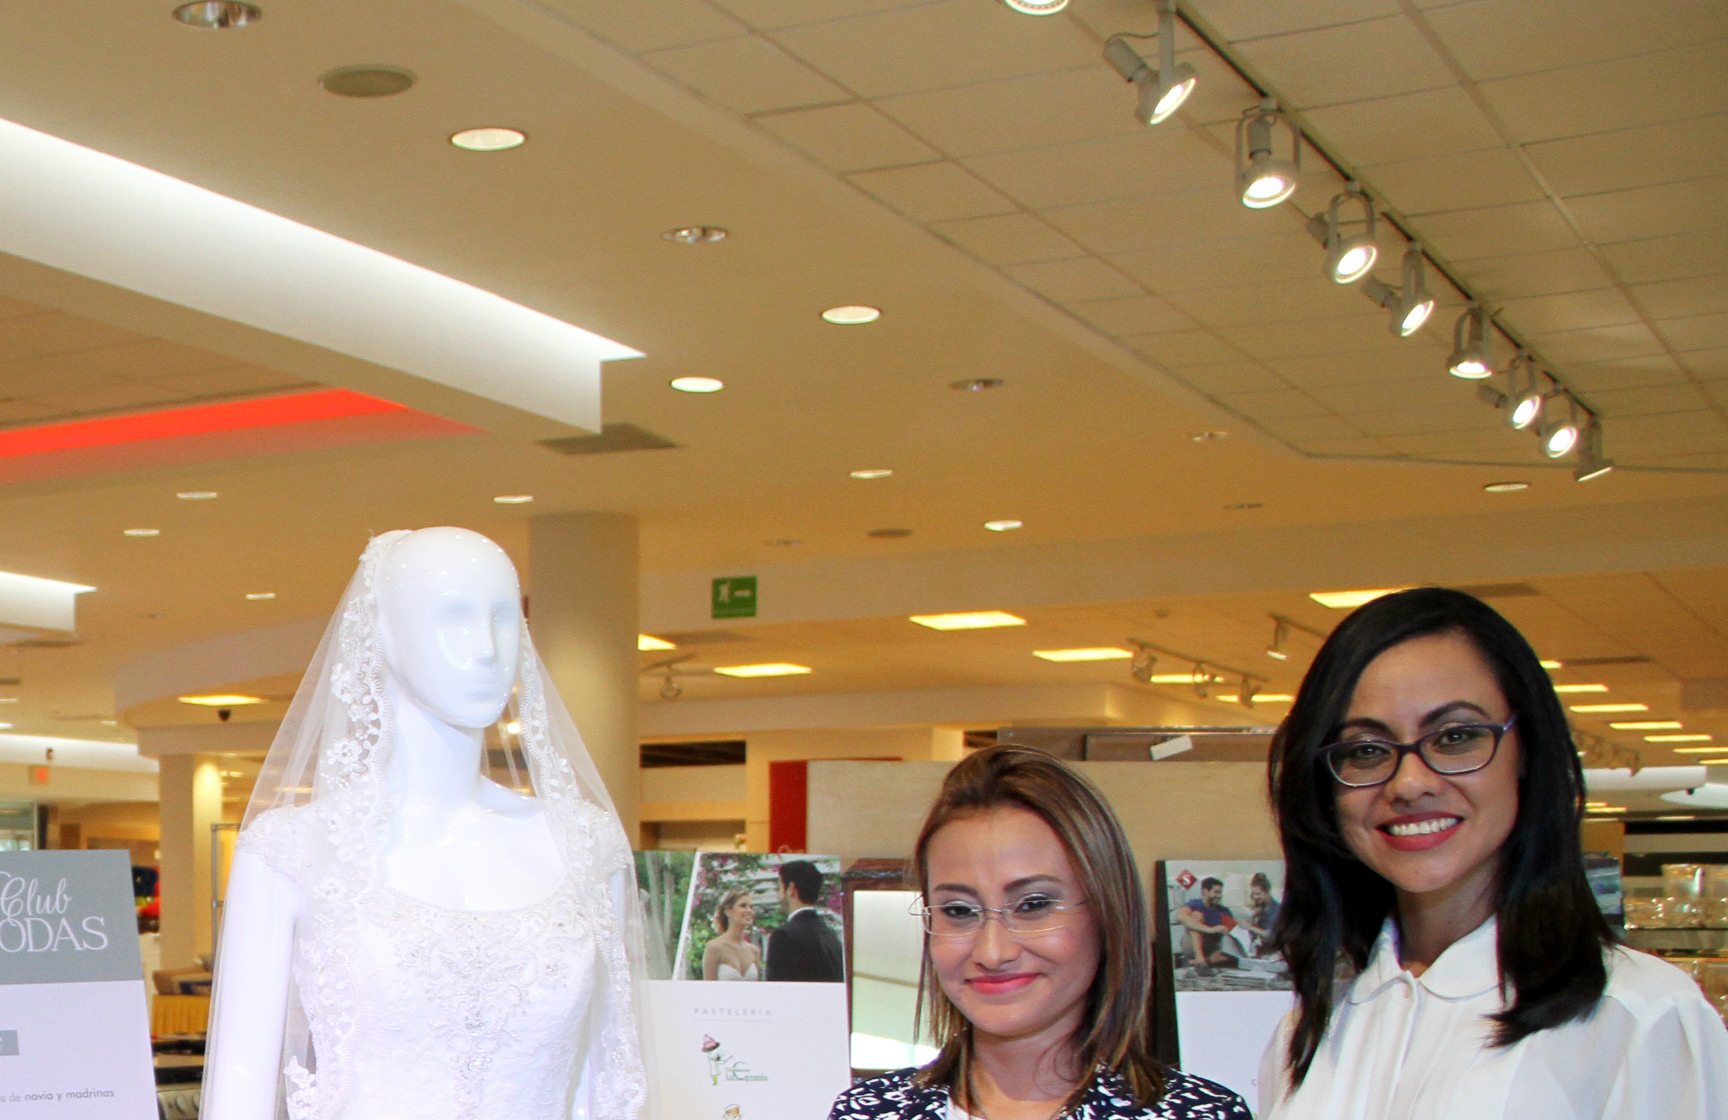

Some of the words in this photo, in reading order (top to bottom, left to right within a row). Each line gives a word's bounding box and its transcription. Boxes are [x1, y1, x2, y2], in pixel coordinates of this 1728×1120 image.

[9, 1092, 22, 1103] de
[24, 1090, 54, 1101] novia
[65, 1087, 115, 1100] madrinas
